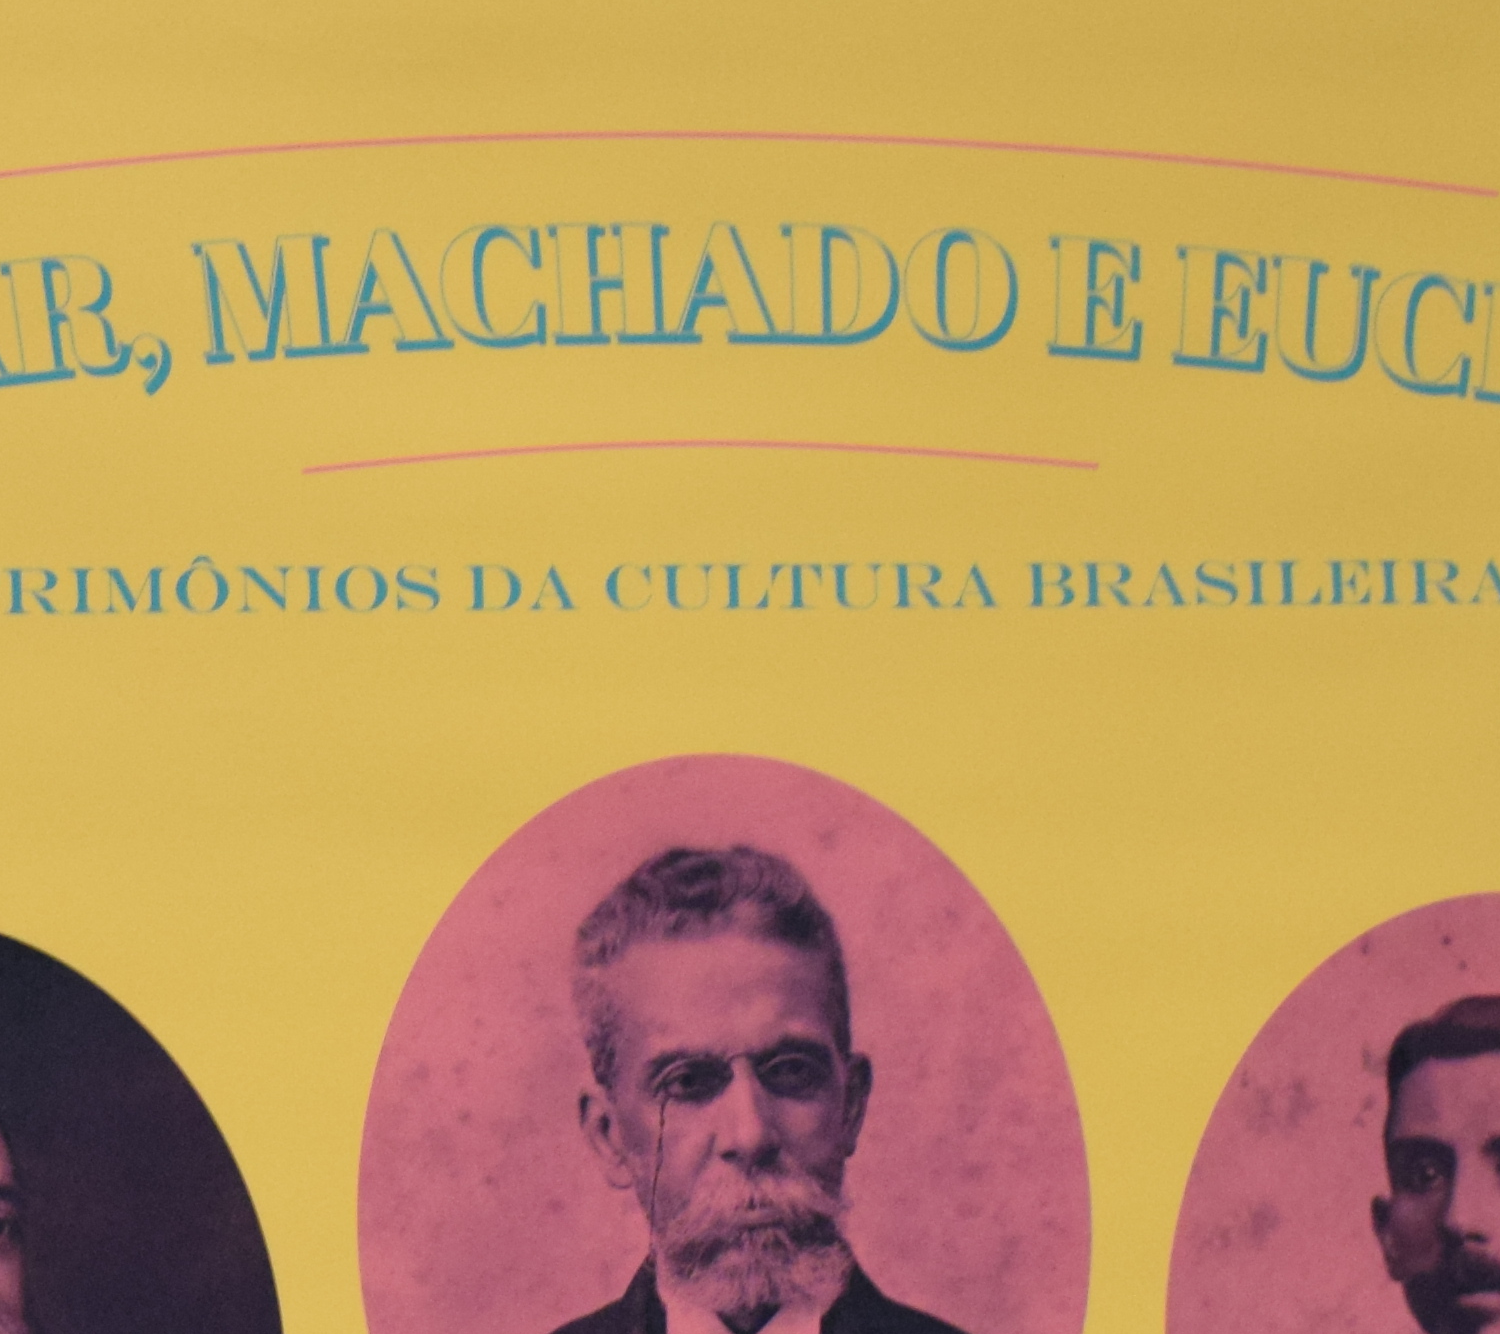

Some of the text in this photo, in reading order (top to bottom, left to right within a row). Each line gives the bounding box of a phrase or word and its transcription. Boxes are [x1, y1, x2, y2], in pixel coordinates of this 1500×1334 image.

[190, 220, 1022, 368] MACHADO
[1046, 234, 1145, 364] E
[467, 562, 577, 614] DA
[603, 560, 999, 612] CULTURA
